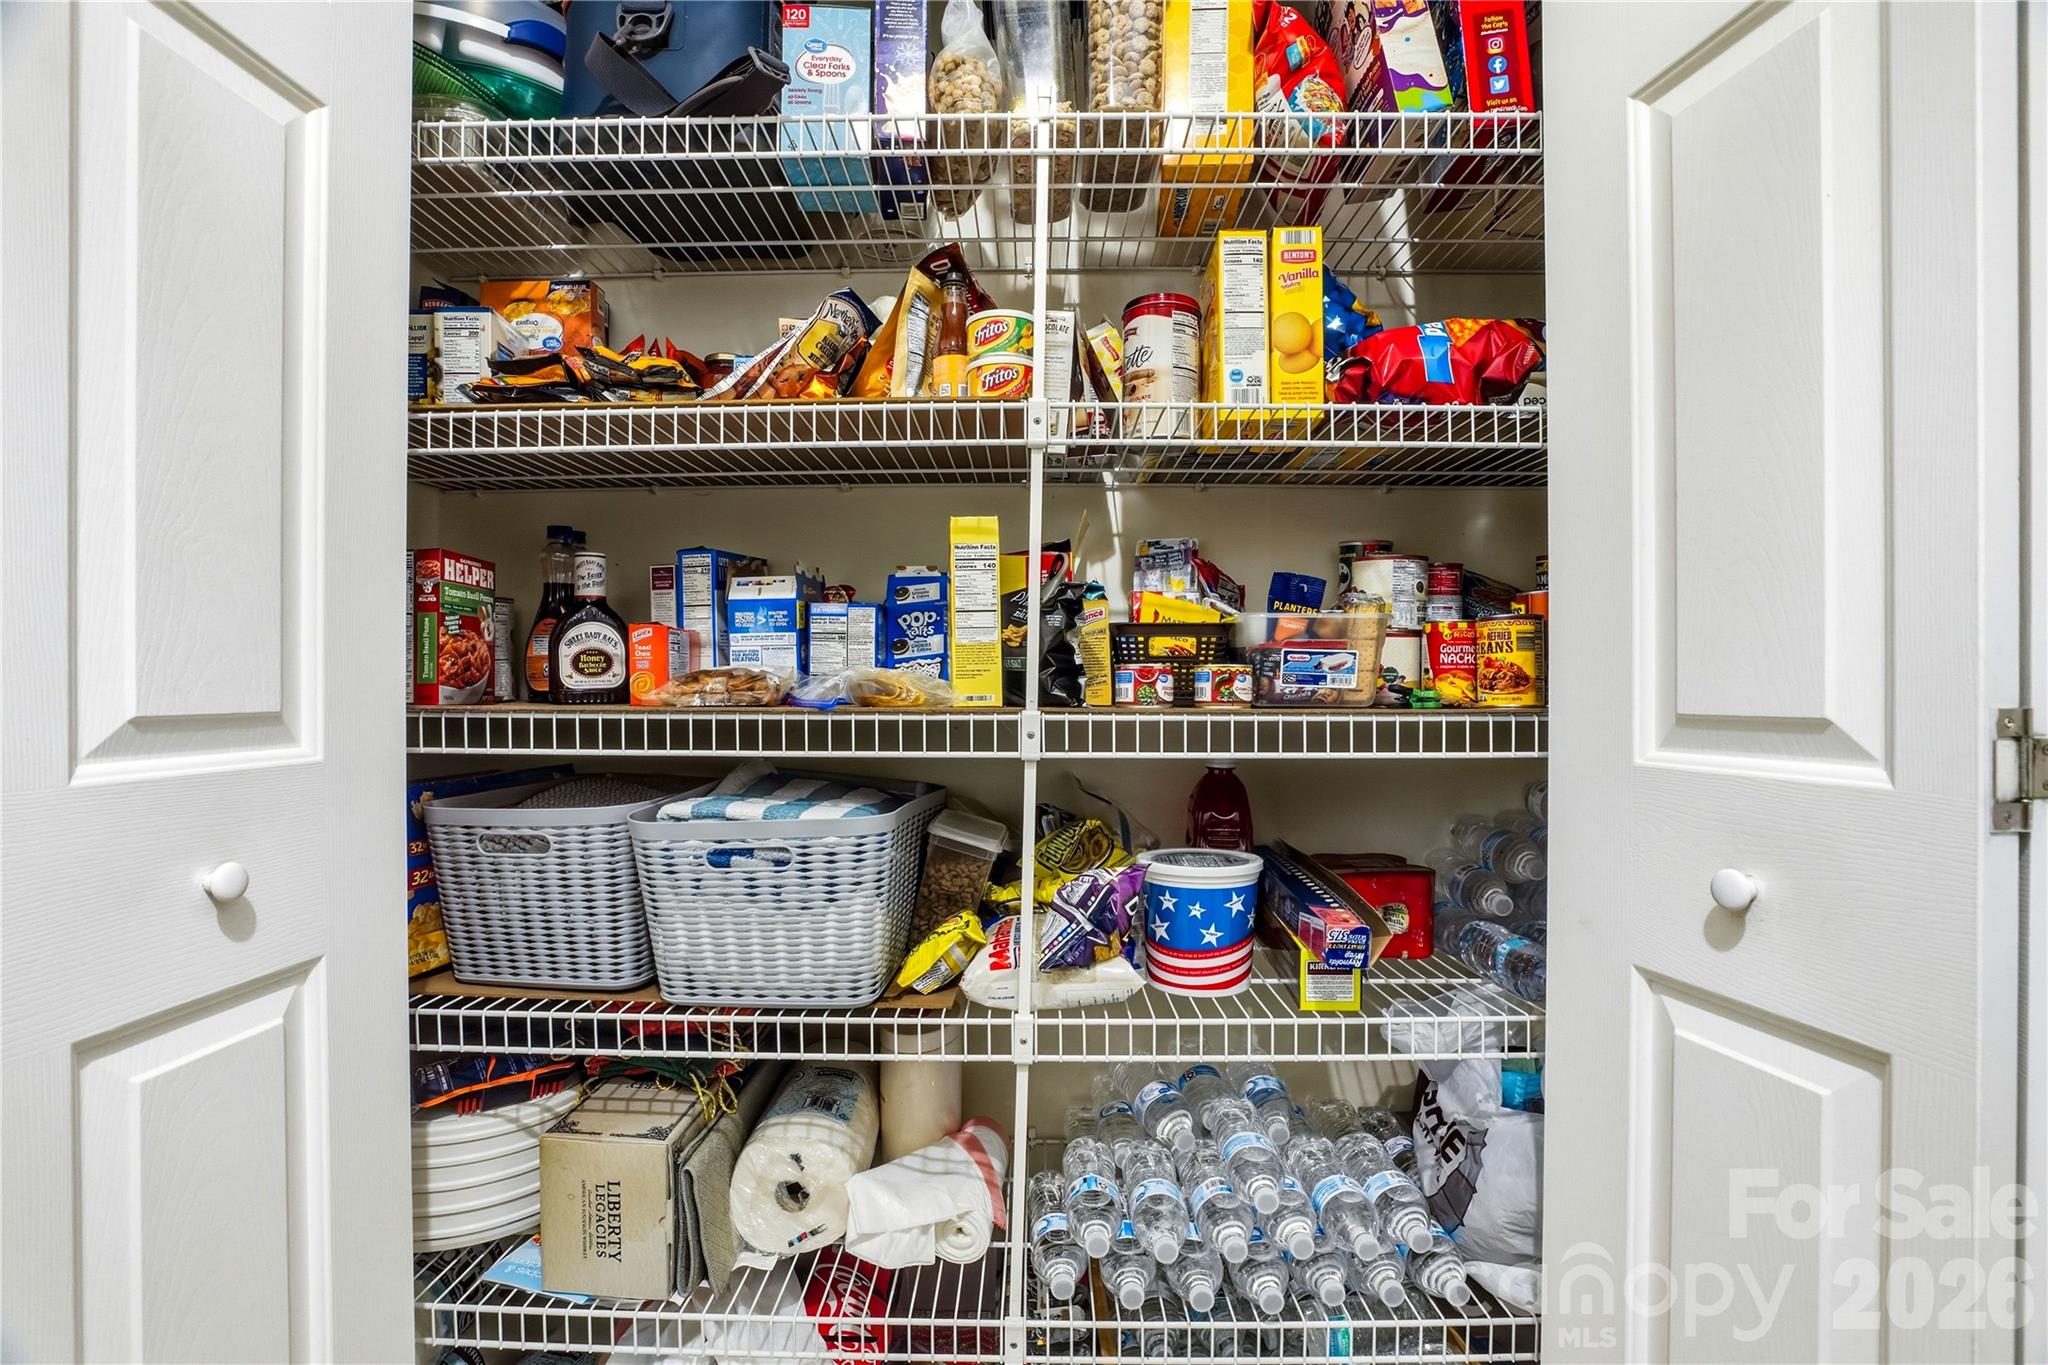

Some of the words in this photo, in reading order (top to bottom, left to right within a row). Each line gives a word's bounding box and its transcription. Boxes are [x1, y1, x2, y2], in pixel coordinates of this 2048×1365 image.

[786, 9, 807, 20] 120
[811, 55, 843, 63] Everyday
[803, 62, 826, 70] Clear
[828, 62, 850, 71] Forks
[807, 69, 815, 77] &
[816, 69, 847, 78] Spoons
[1283, 250, 1315, 260] BENTON'S
[1278, 267, 1320, 283] Vanilla
[974, 318, 1009, 346] Fritos
[981, 367, 1018, 391] Fritos
[443, 557, 495, 590] HELPER
[443, 586, 467, 599] Tomato
[466, 590, 480, 601] Basil
[480, 593, 494, 604] Penne
[1273, 600, 1318, 616] PLANTERS
[422, 617, 430, 636] Penne
[633, 628, 651, 639] Lance
[1486, 630, 1511, 641] REFRIED
[564, 632, 583, 650] SWEET
[584, 631, 601, 640] BABY
[580, 654, 605, 663] Honey
[1344, 950, 1366, 959] Wrap
[1328, 958, 1363, 967] Reynolds
[595, 1184, 607, 1259] LEGACIES
[607, 1180, 622, 1264] LIBERTY
